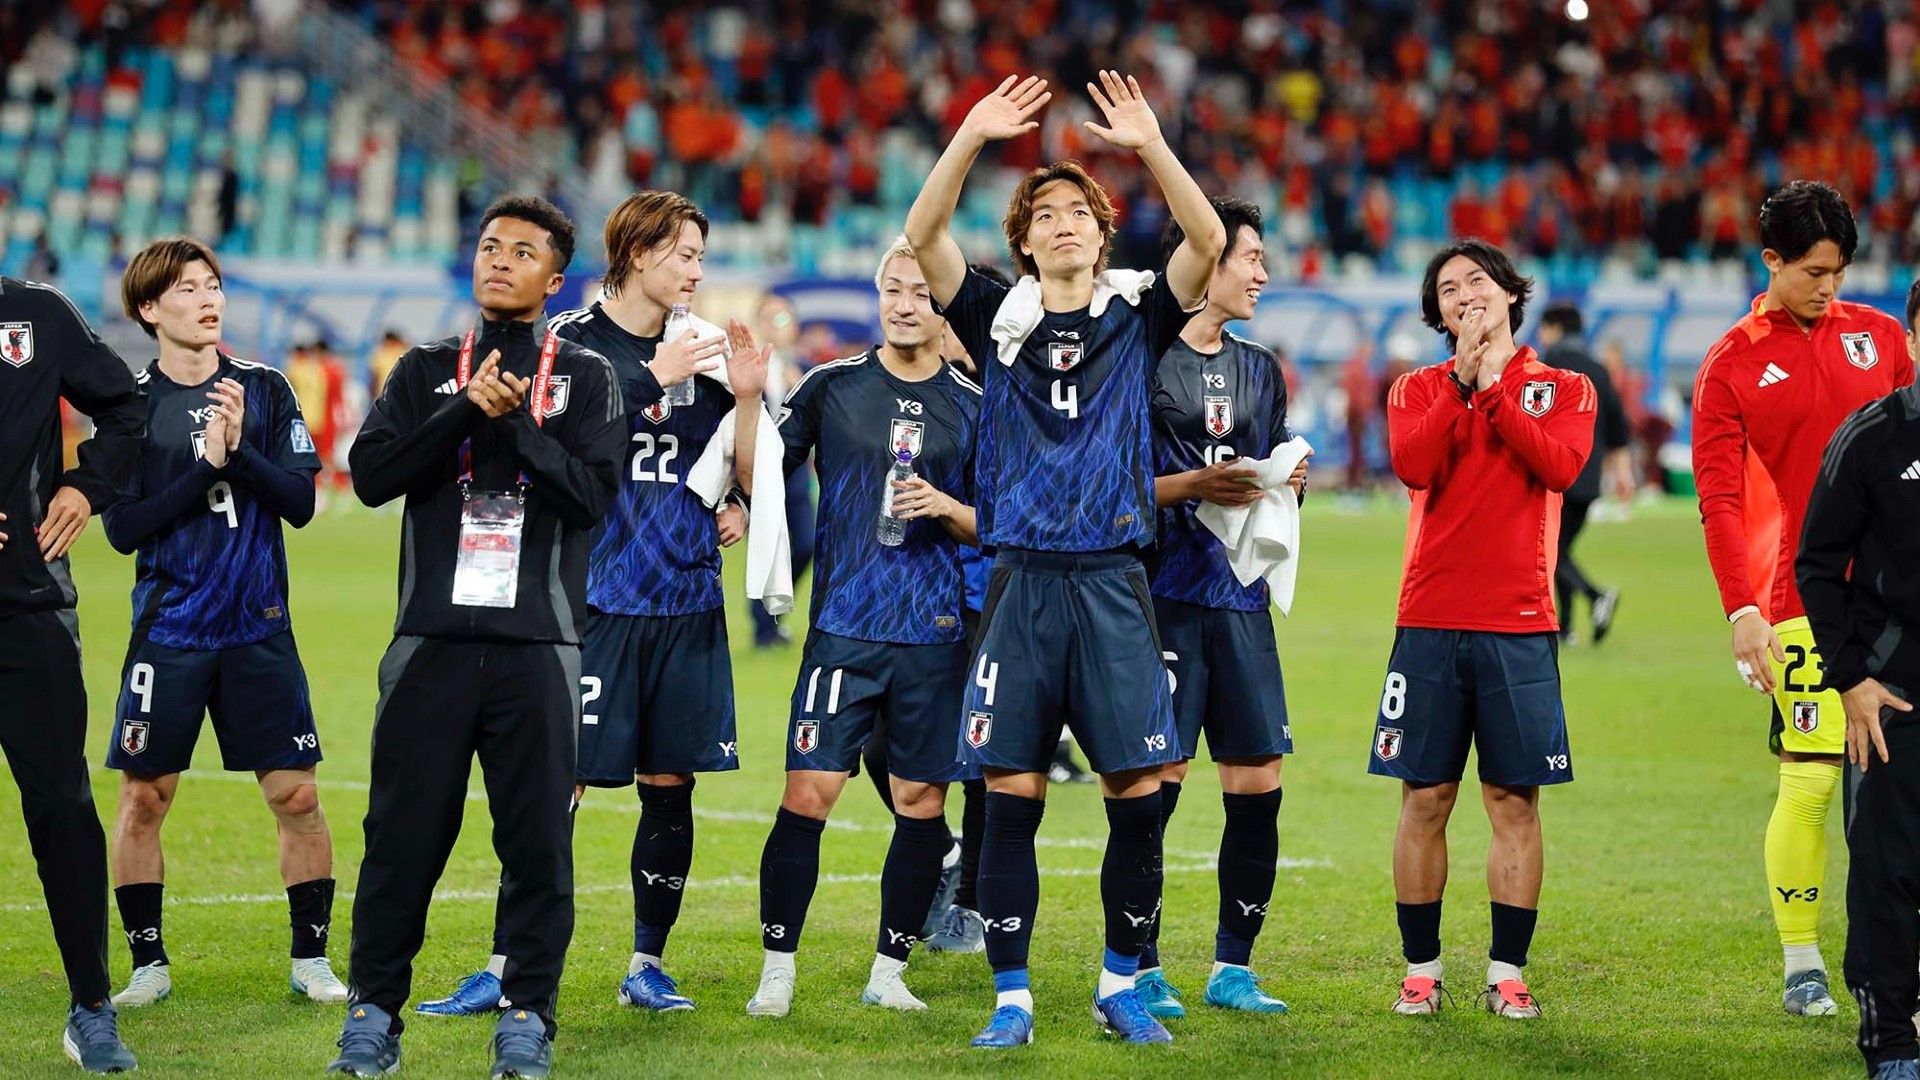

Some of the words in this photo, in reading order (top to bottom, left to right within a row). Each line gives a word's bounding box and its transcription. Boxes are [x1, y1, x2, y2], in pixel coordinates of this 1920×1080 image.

[1051, 330, 1080, 340] Y-3
[1202, 373, 1226, 390] Y-3
[896, 398, 924, 416] Y-3
[1051, 379, 1078, 419] 4
[631, 432, 679, 483] 22
[207, 481, 239, 529] 9
[975, 653, 999, 706] 4
[1784, 645, 1829, 693] 23
[130, 662, 155, 713] 9
[804, 666, 843, 714] 11
[1381, 671, 1407, 720] 8
[293, 733, 317, 751] Y-3
[1144, 734, 1166, 752] Y-3
[1545, 754, 1568, 771] Y-3
[643, 868, 684, 891] Y-3
[1776, 886, 1819, 904] Y-3
[124, 927, 158, 944] Y-3
[982, 916, 1022, 933] Y-3
[887, 927, 918, 949] Y-3
